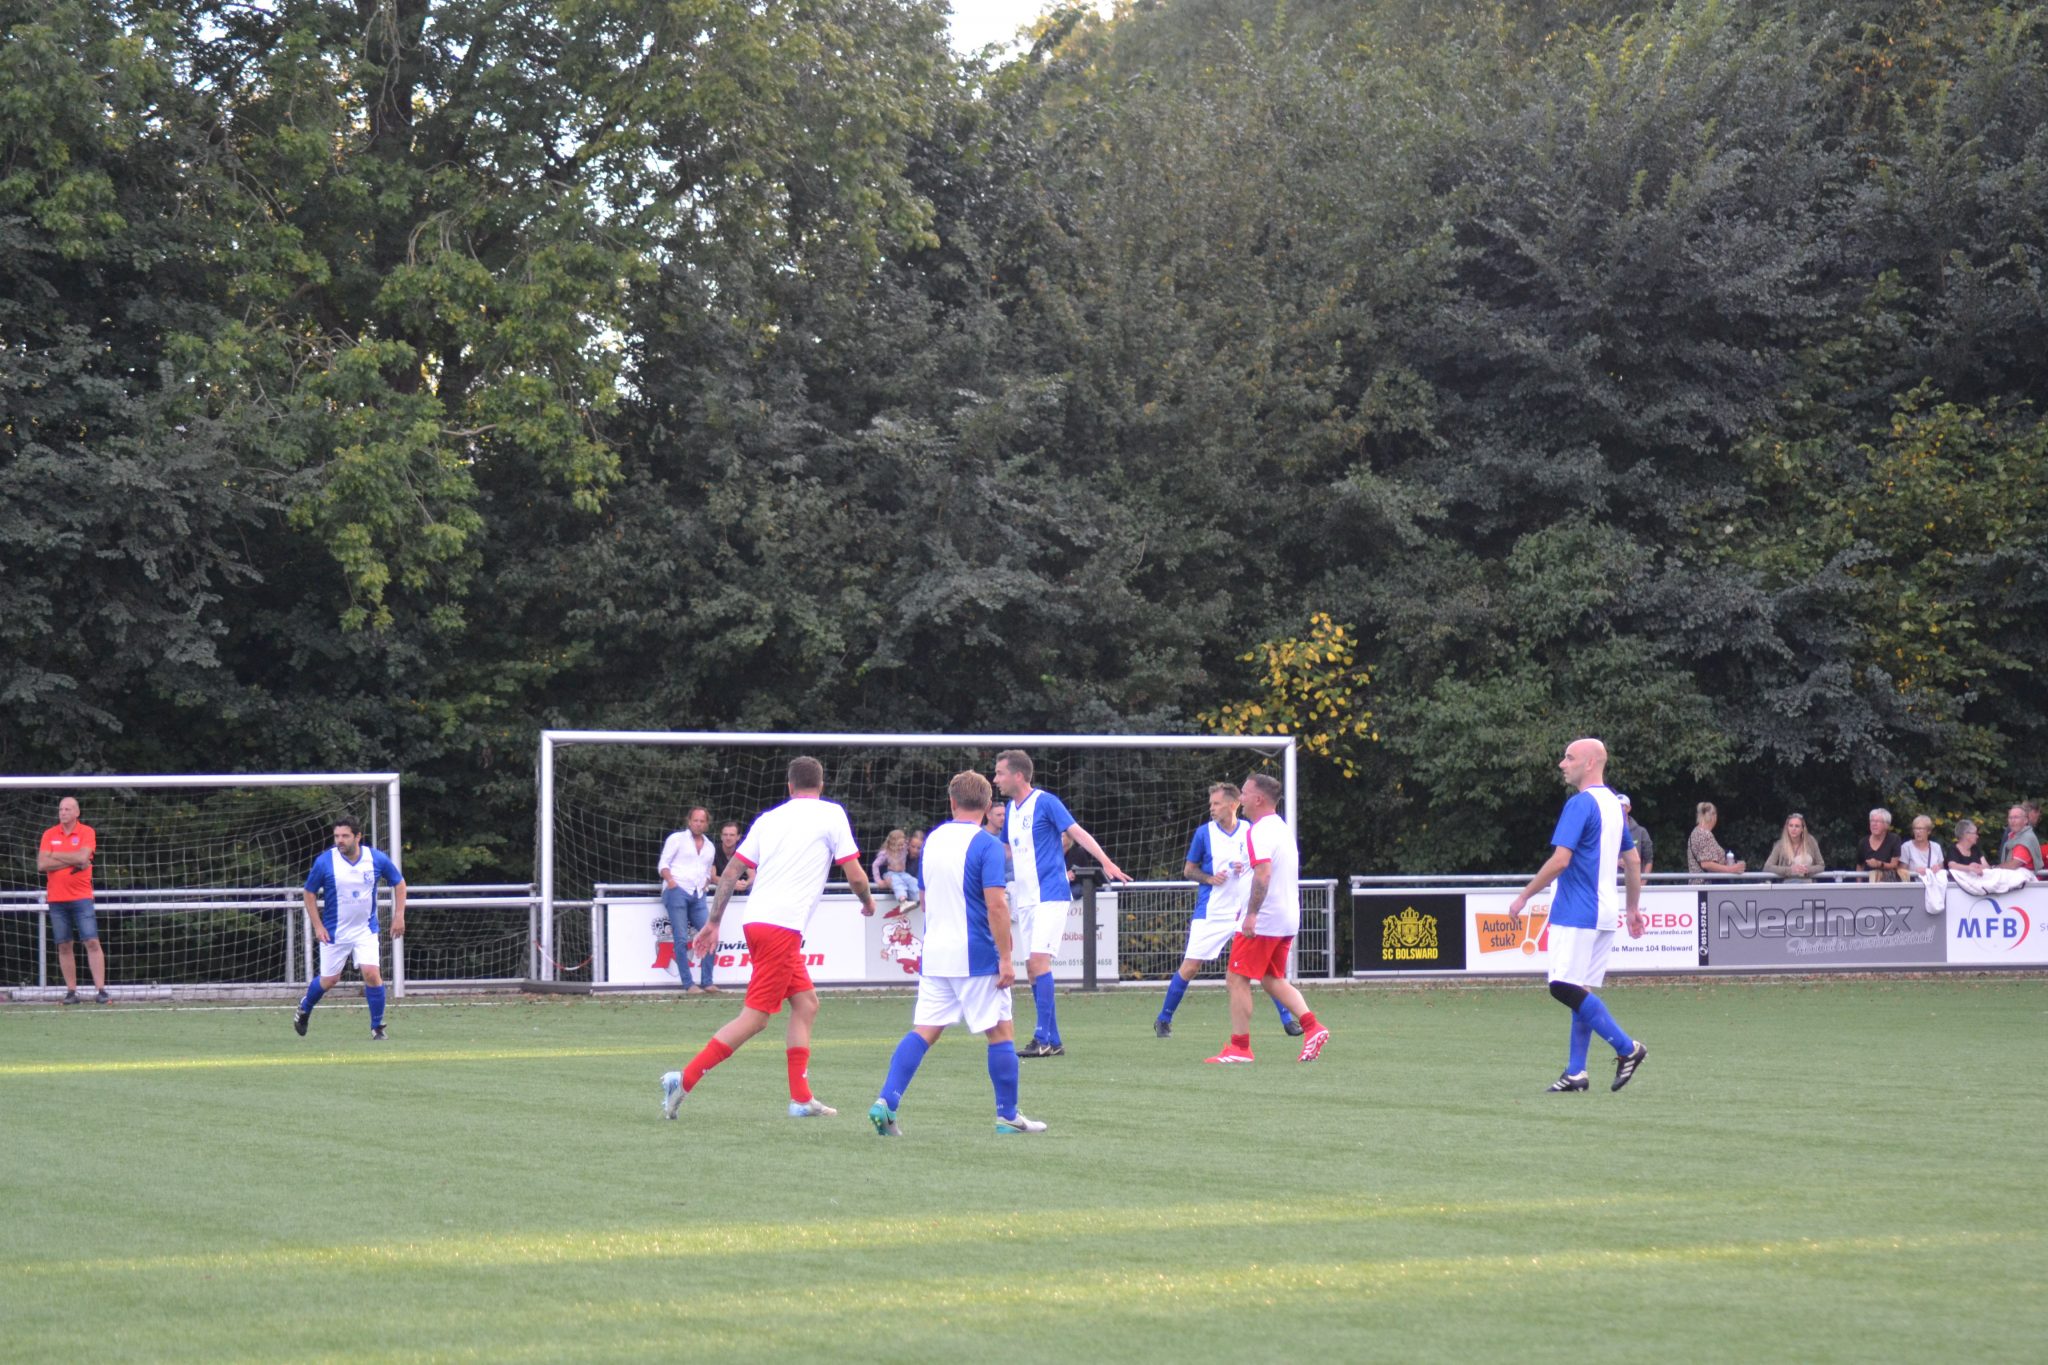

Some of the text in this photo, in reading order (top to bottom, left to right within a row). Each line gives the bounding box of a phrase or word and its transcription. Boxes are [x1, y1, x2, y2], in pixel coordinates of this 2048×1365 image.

[1718, 899, 1914, 939] Nedinox
[1957, 917, 2018, 939] MFB
[1490, 933, 1516, 947] stuk?
[1382, 947, 1439, 960] SC BOLSWARD
[1661, 944, 1693, 952] Bolsward
